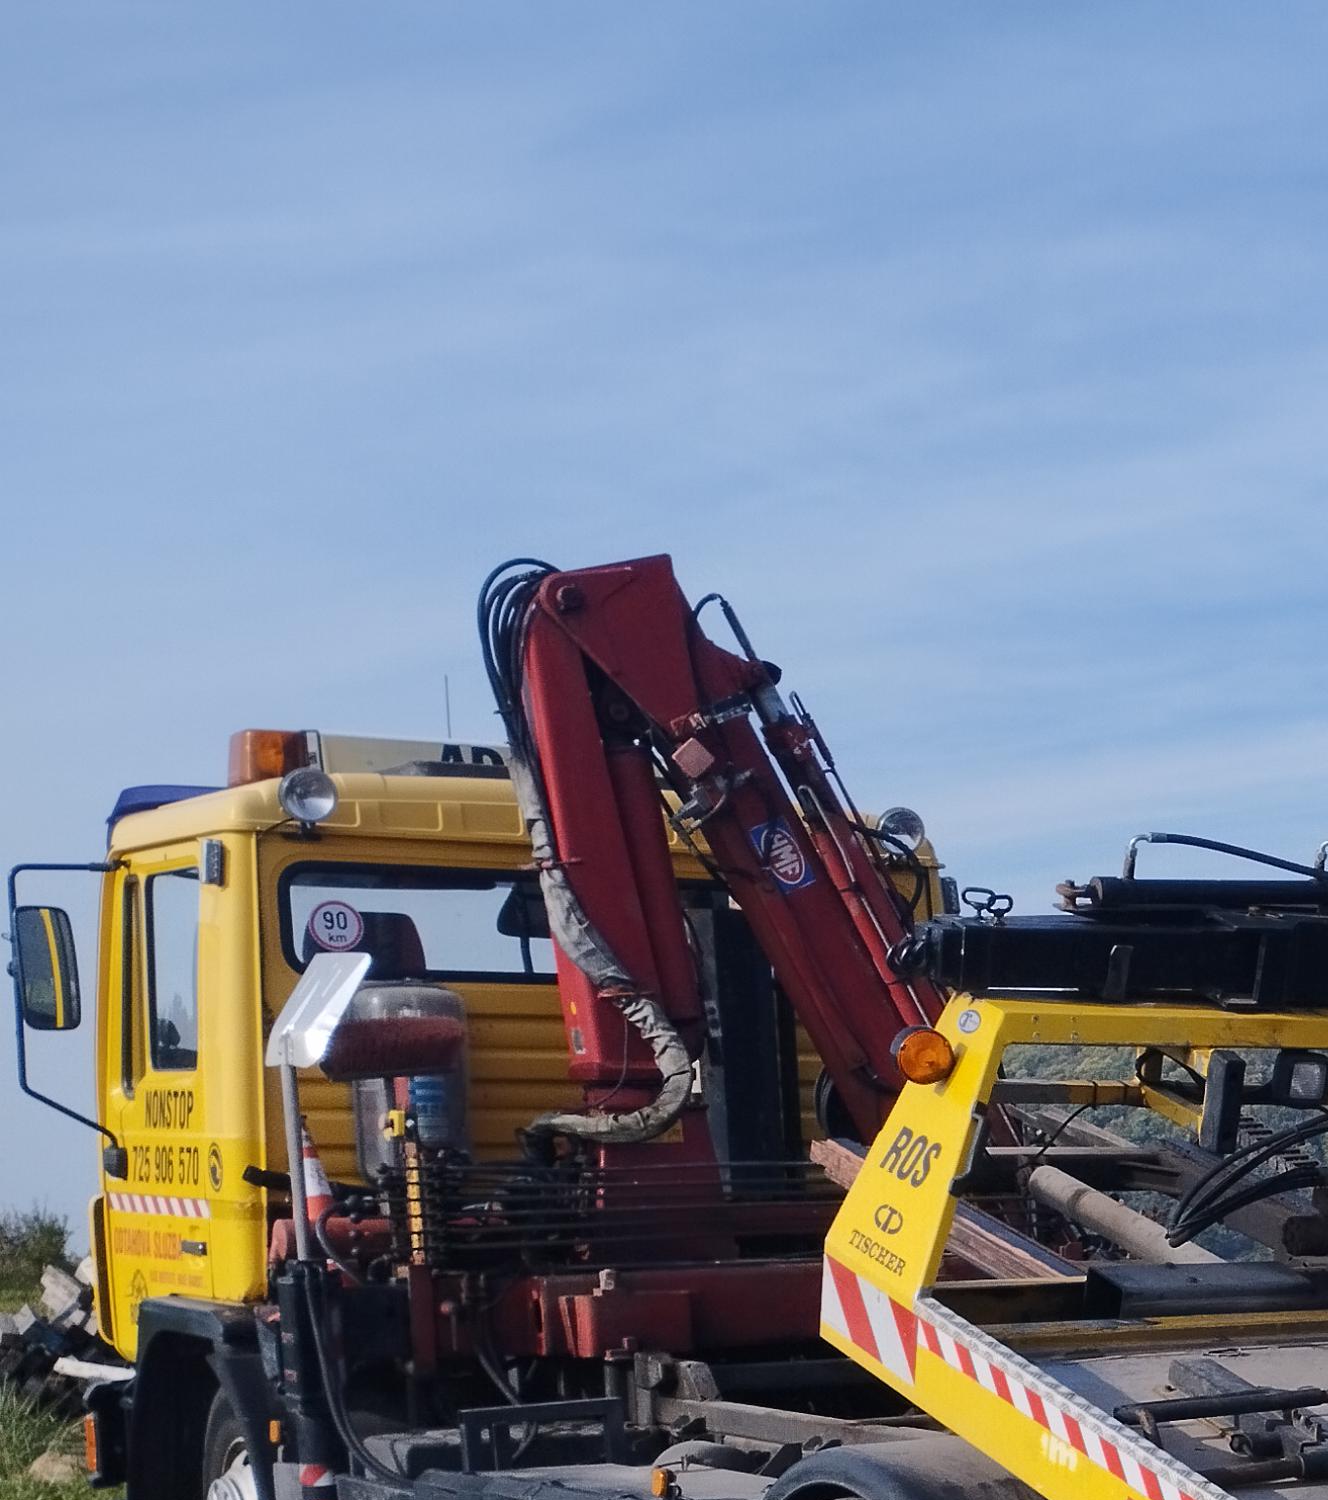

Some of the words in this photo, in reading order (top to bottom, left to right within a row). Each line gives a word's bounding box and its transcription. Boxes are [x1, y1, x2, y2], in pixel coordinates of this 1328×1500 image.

[322, 911, 348, 930] 90
[328, 933, 348, 943] km
[145, 1089, 194, 1129] NONSTOP
[132, 1145, 151, 1182] 725
[155, 1145, 174, 1184] 906
[178, 1147, 199, 1186] 570
[880, 1126, 942, 1188] ROS
[849, 1229, 906, 1276] TISCHER
